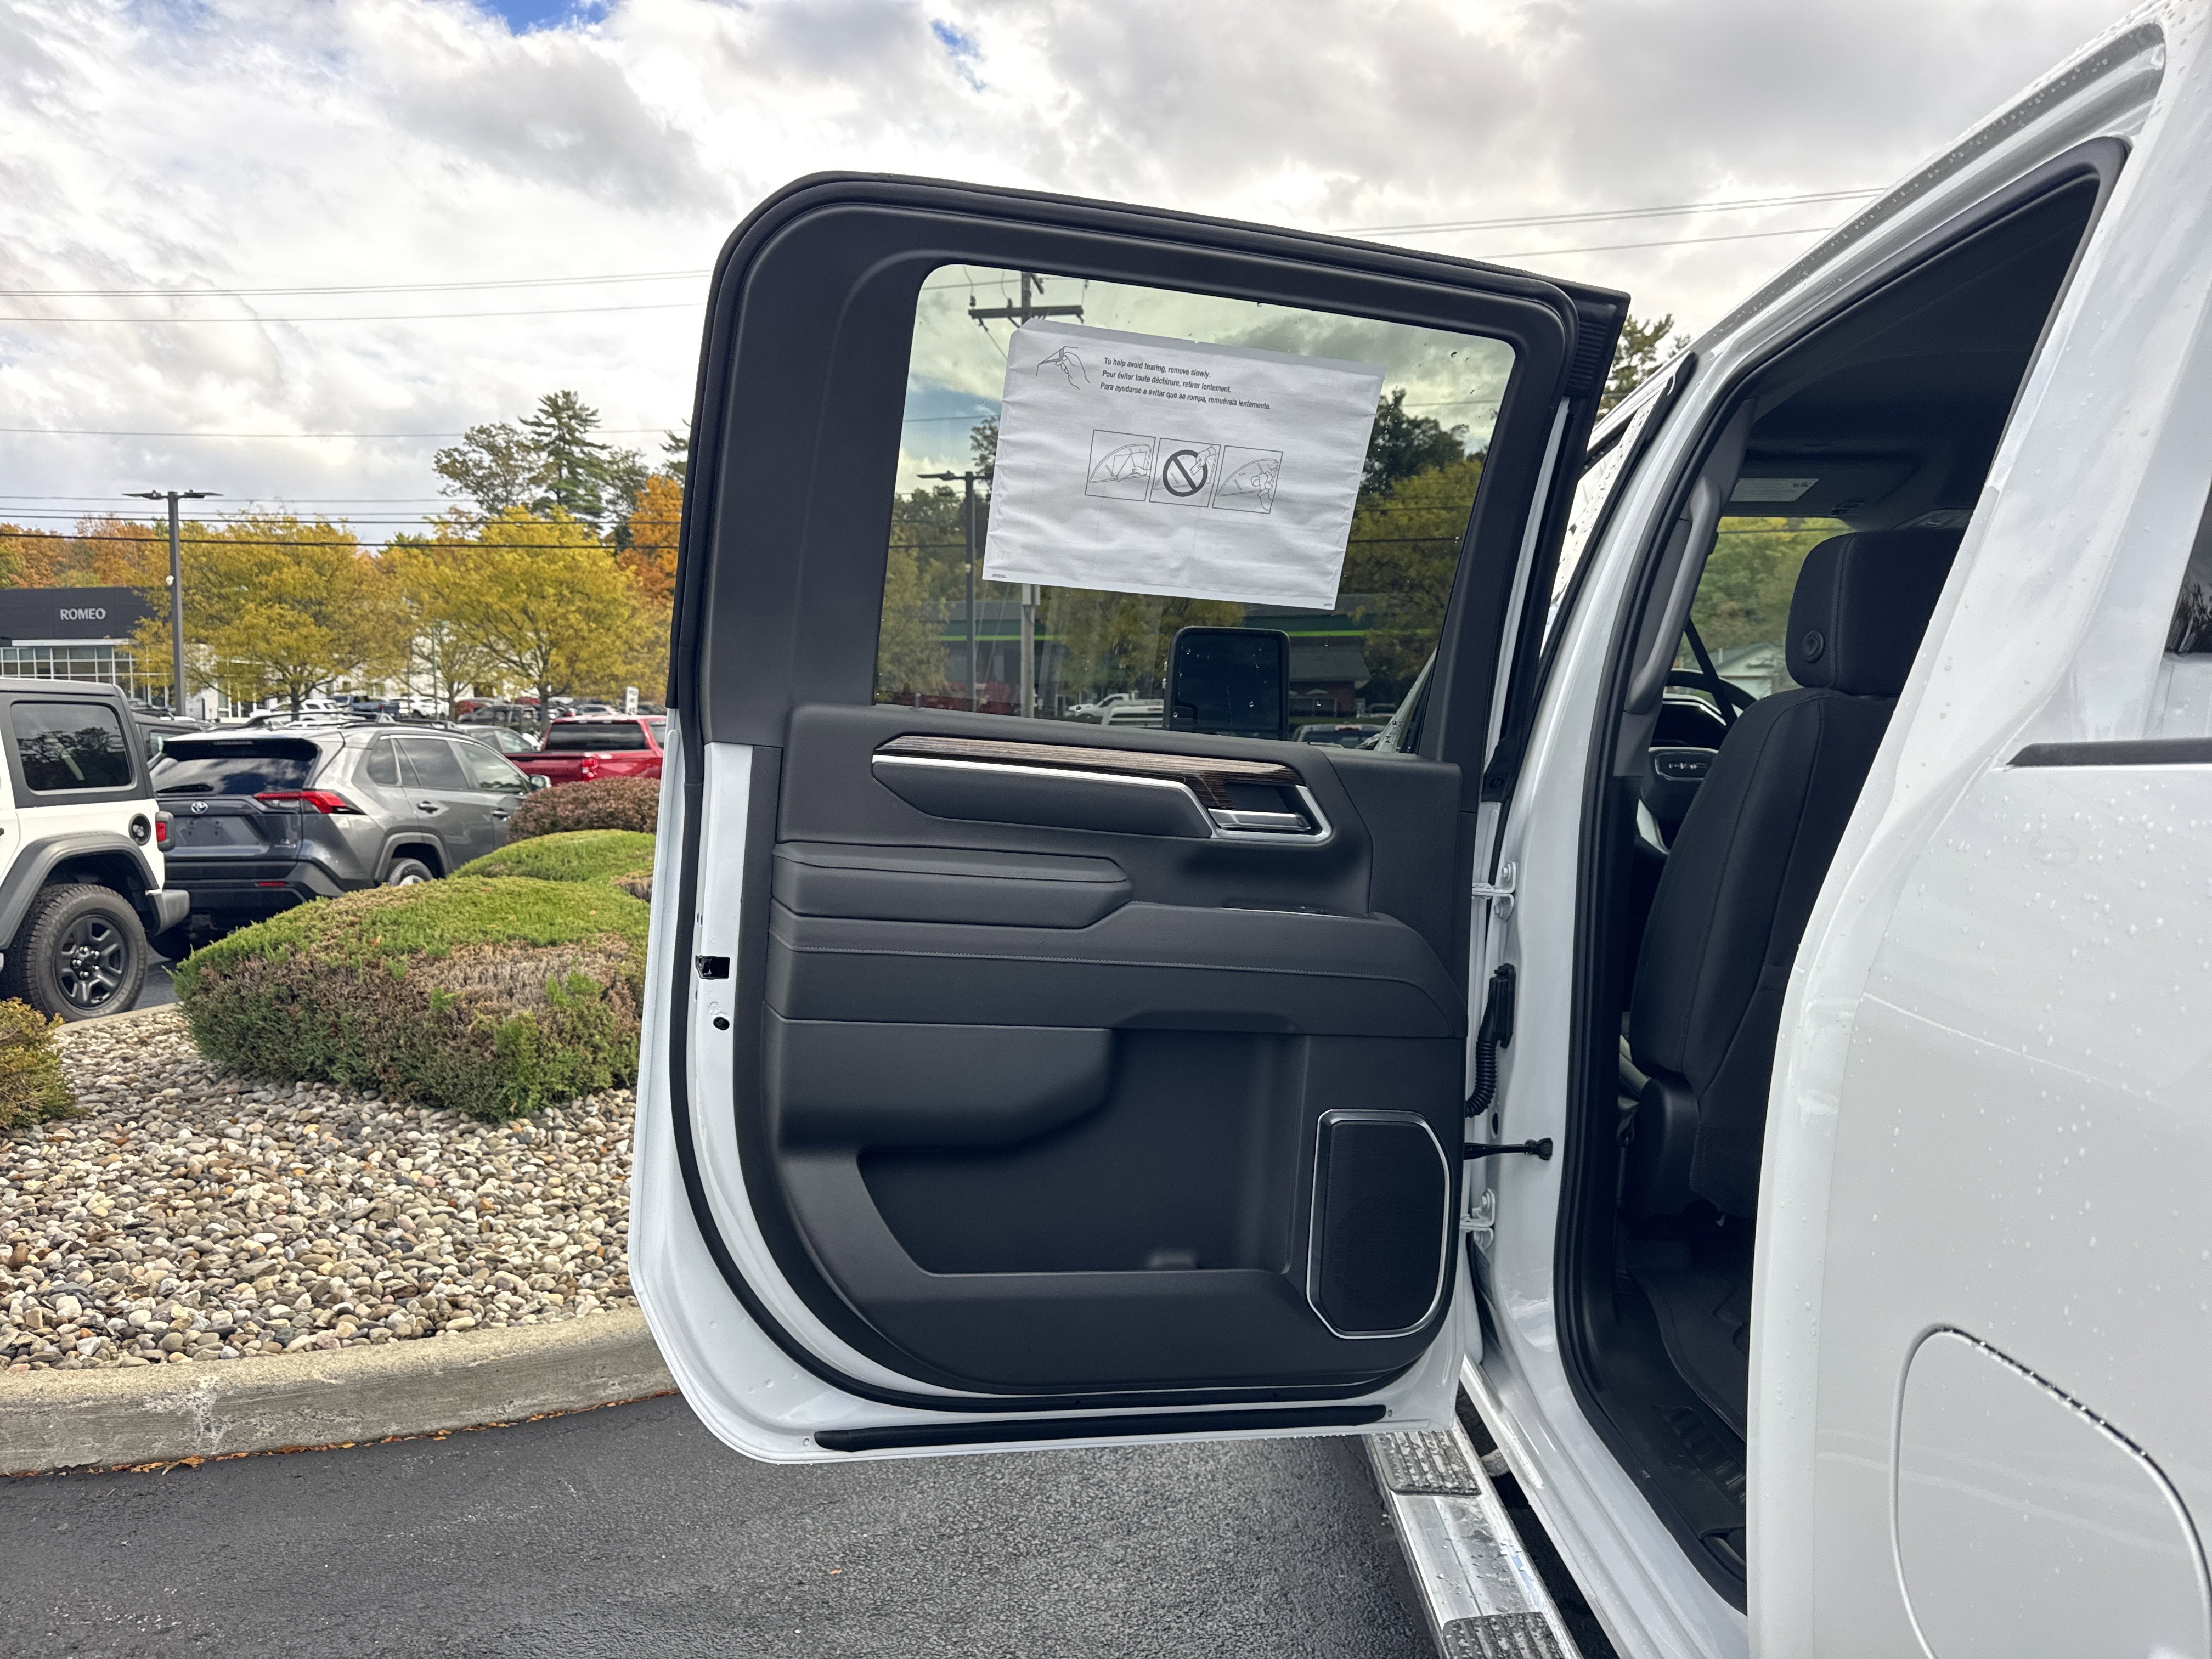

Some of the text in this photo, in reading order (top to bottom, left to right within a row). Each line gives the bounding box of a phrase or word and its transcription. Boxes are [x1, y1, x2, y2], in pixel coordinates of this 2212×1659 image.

[1113, 358, 1126, 368] help
[1144, 363, 1166, 373] tearing,
[1168, 366, 1189, 375] remove
[1190, 369, 1211, 379] slowly.
[1102, 370, 1116, 378] Pour
[1117, 371, 1134, 380] éviter
[1135, 374, 1150, 382] toute
[1152, 376, 1181, 387] déchirure,
[1201, 382, 1231, 392] lentement.
[1115, 385, 1142, 394] ayudarse
[1187, 395, 1207, 403] rompa,
[1208, 397, 1237, 406] remuévala
[1238, 399, 1271, 410] lentamente.
[60, 608, 106, 620] ROMEO
